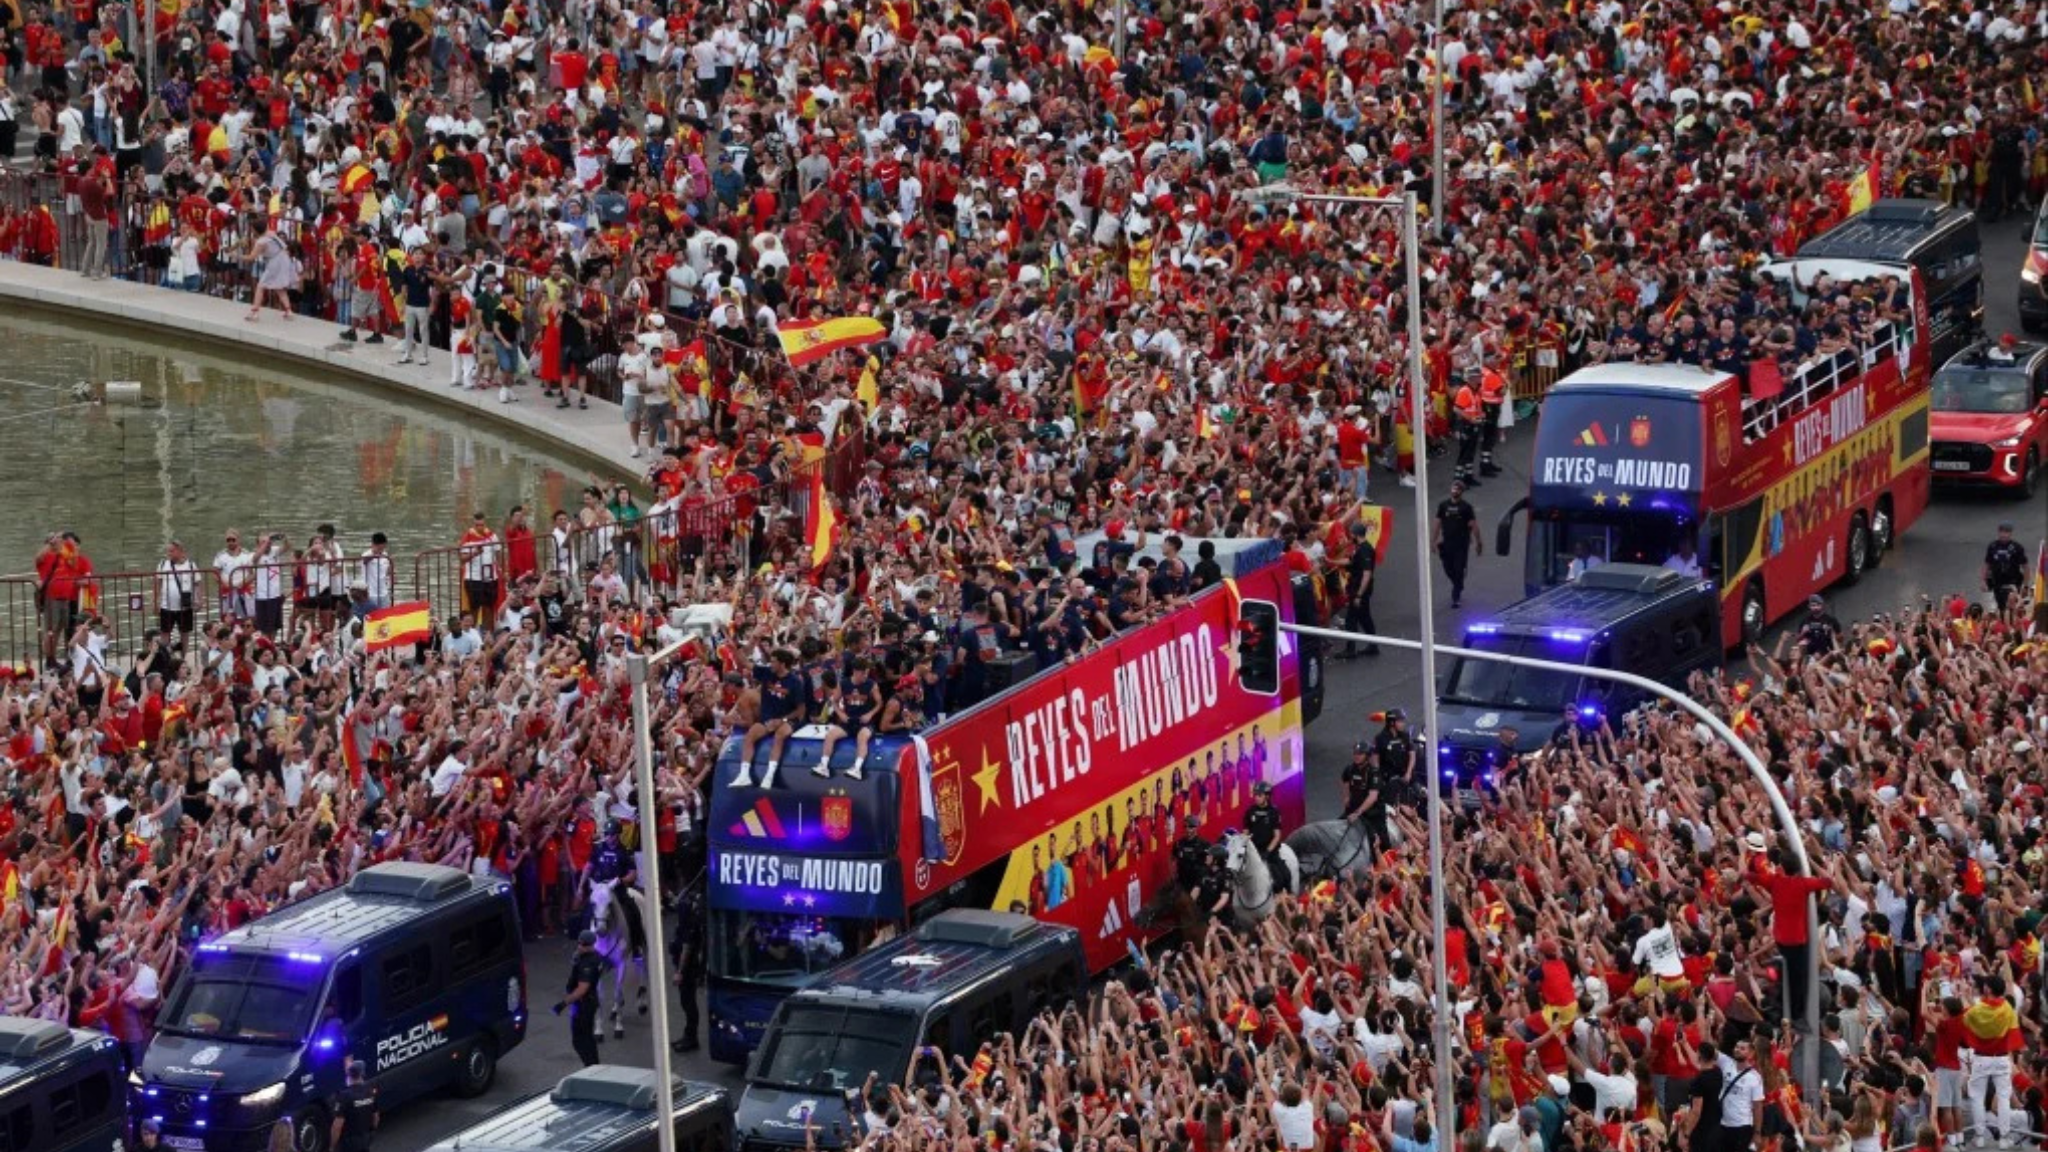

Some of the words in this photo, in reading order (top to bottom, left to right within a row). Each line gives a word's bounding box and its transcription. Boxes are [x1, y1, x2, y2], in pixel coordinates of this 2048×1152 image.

[1794, 407, 1823, 467] REYES
[1830, 383, 1866, 445] MUNDO
[1543, 457, 1596, 484] REYES
[1597, 463, 1613, 478] DEL
[1614, 459, 1691, 490] MUNDO
[1005, 687, 1092, 809] REYES
[1091, 692, 1116, 742] DEL
[1114, 623, 1217, 752] MUNDO
[720, 853, 780, 887] REYES
[782, 863, 800, 881] DEL
[801, 858, 882, 894] MUNDO
[377, 1031, 449, 1071] NACIONAL
